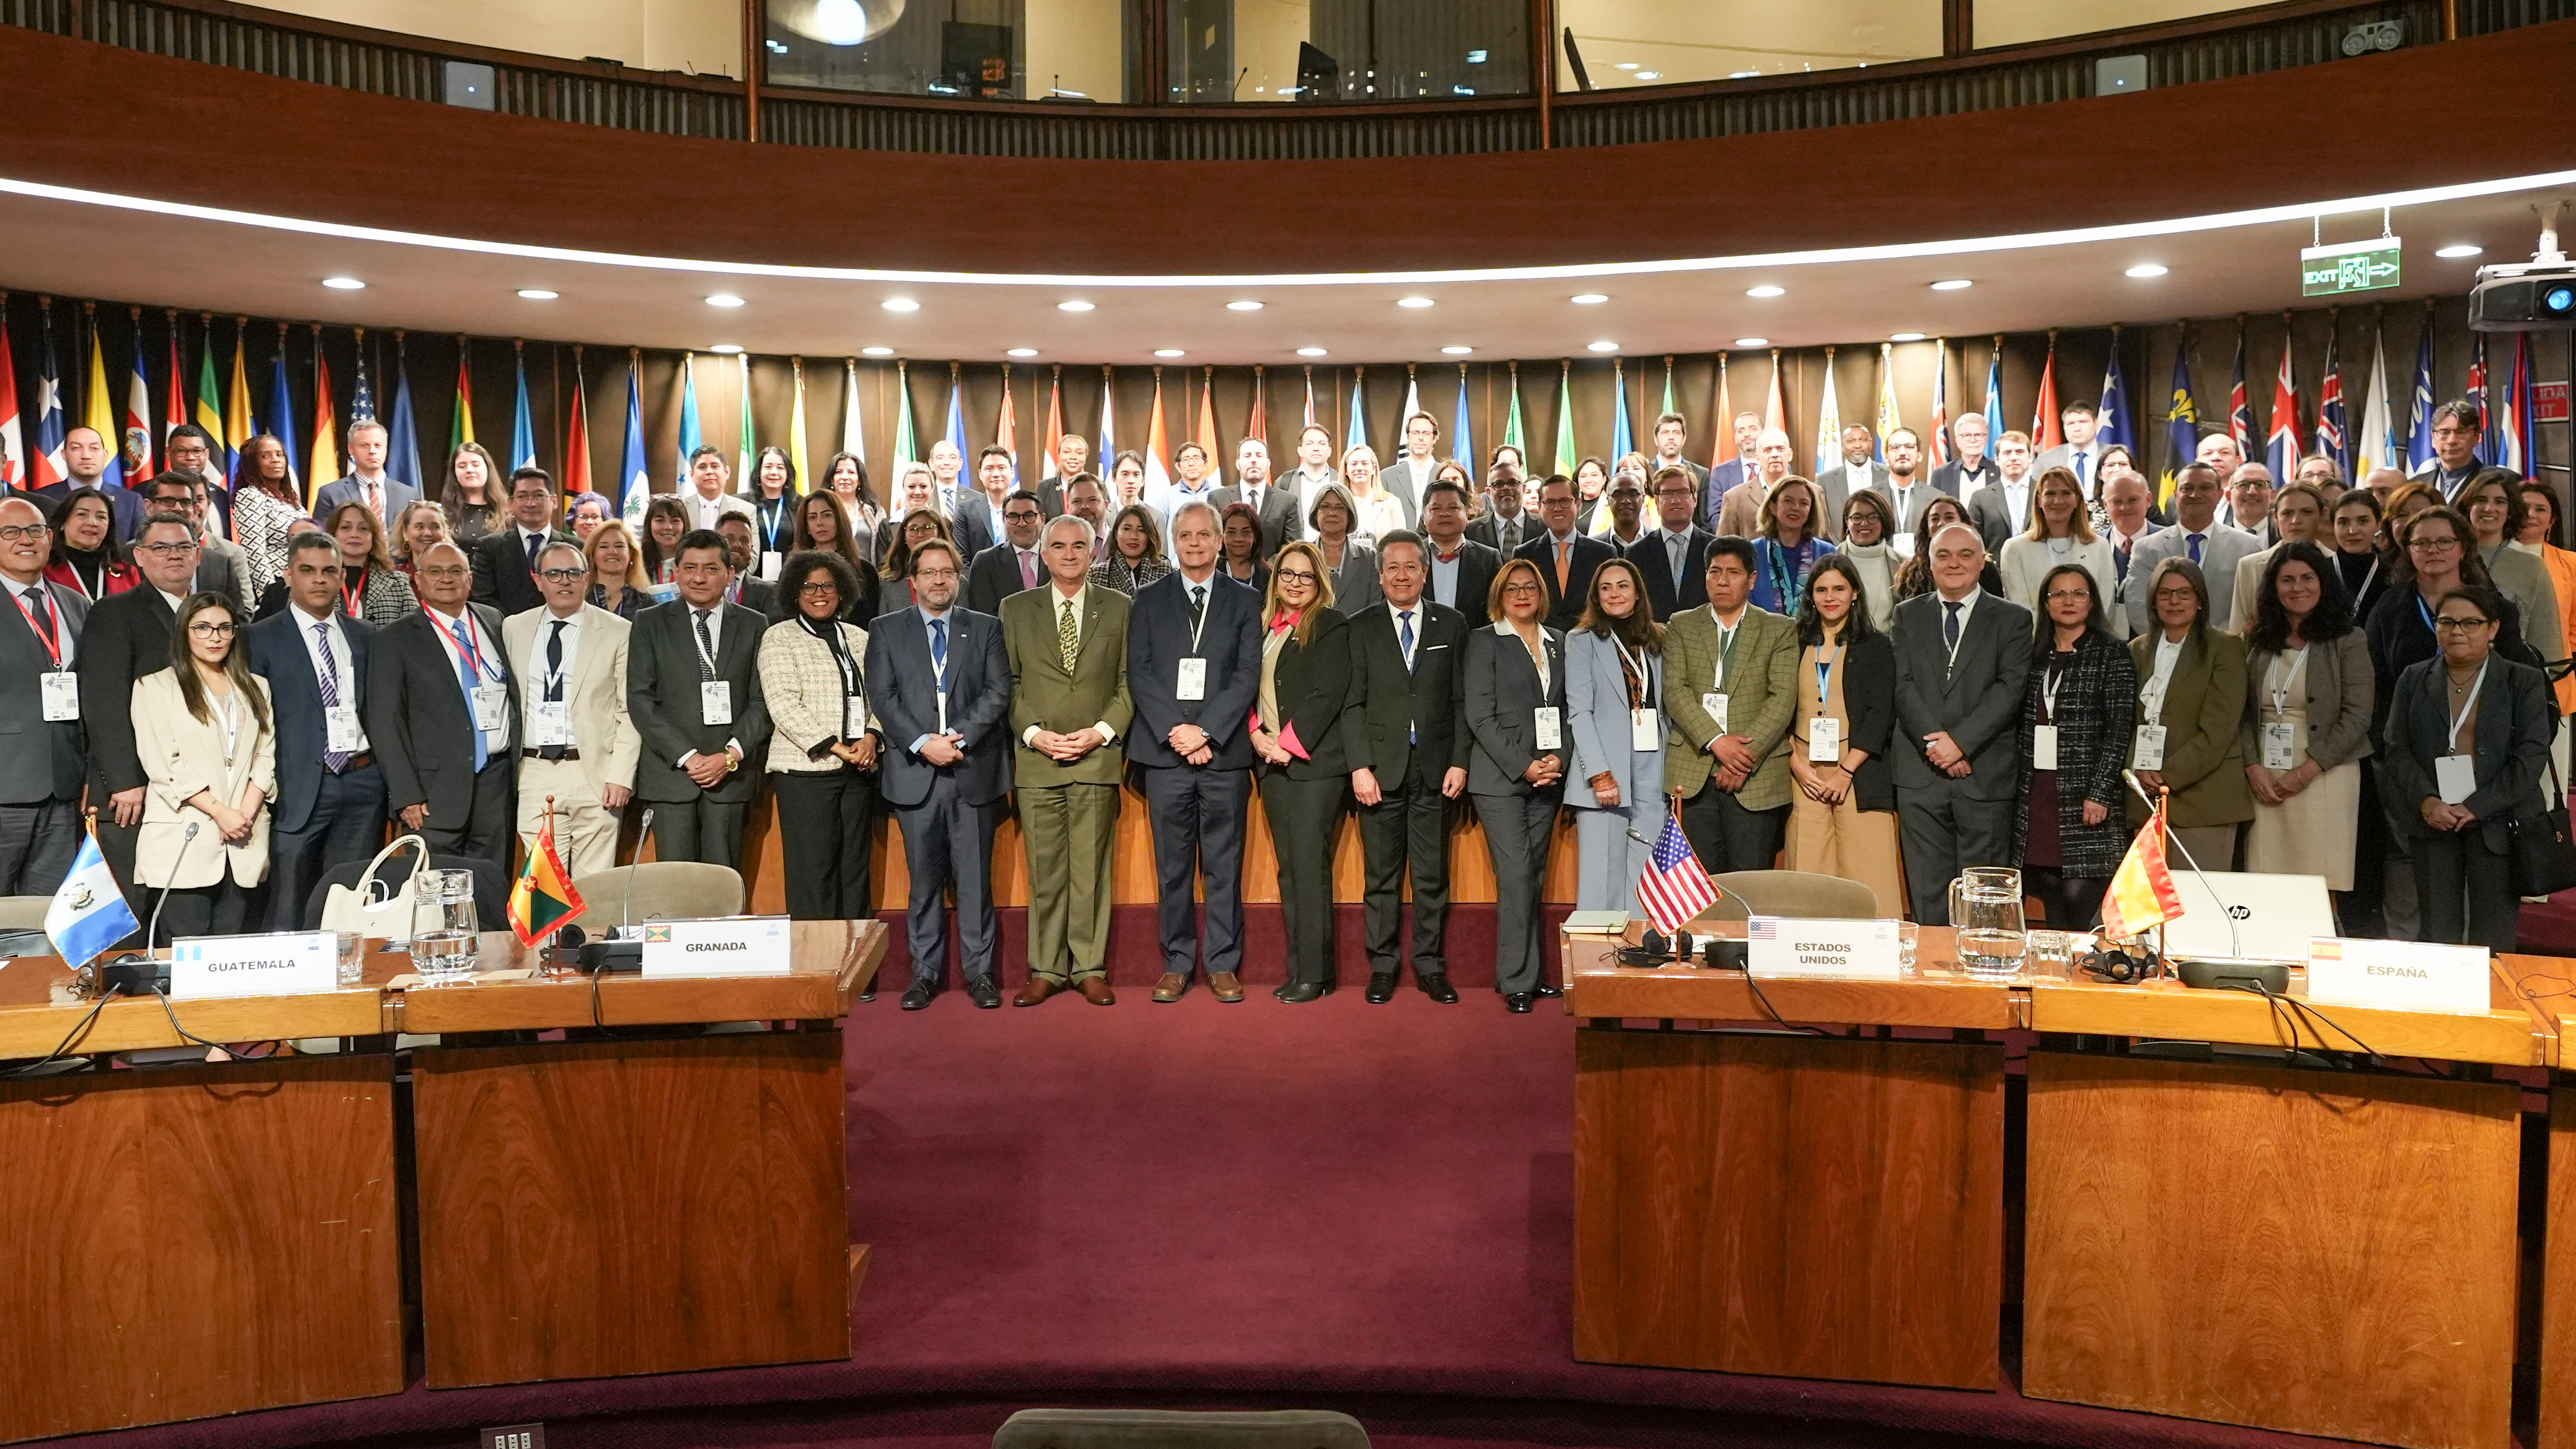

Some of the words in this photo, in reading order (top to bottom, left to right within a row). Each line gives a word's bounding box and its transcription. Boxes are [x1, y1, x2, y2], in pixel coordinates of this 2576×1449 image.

[2304, 268, 2339, 285] EXIT
[2532, 386, 2567, 401] LIDA
[2533, 404, 2555, 418] XIT
[2231, 905, 2250, 920] hp
[685, 942, 747, 952] GRANADA
[1794, 943, 1852, 953] ESTADOS
[208, 959, 296, 972] GUATEMALA
[1800, 955, 1846, 965] UNIDOS
[2367, 965, 2428, 979] ESPAÑA
